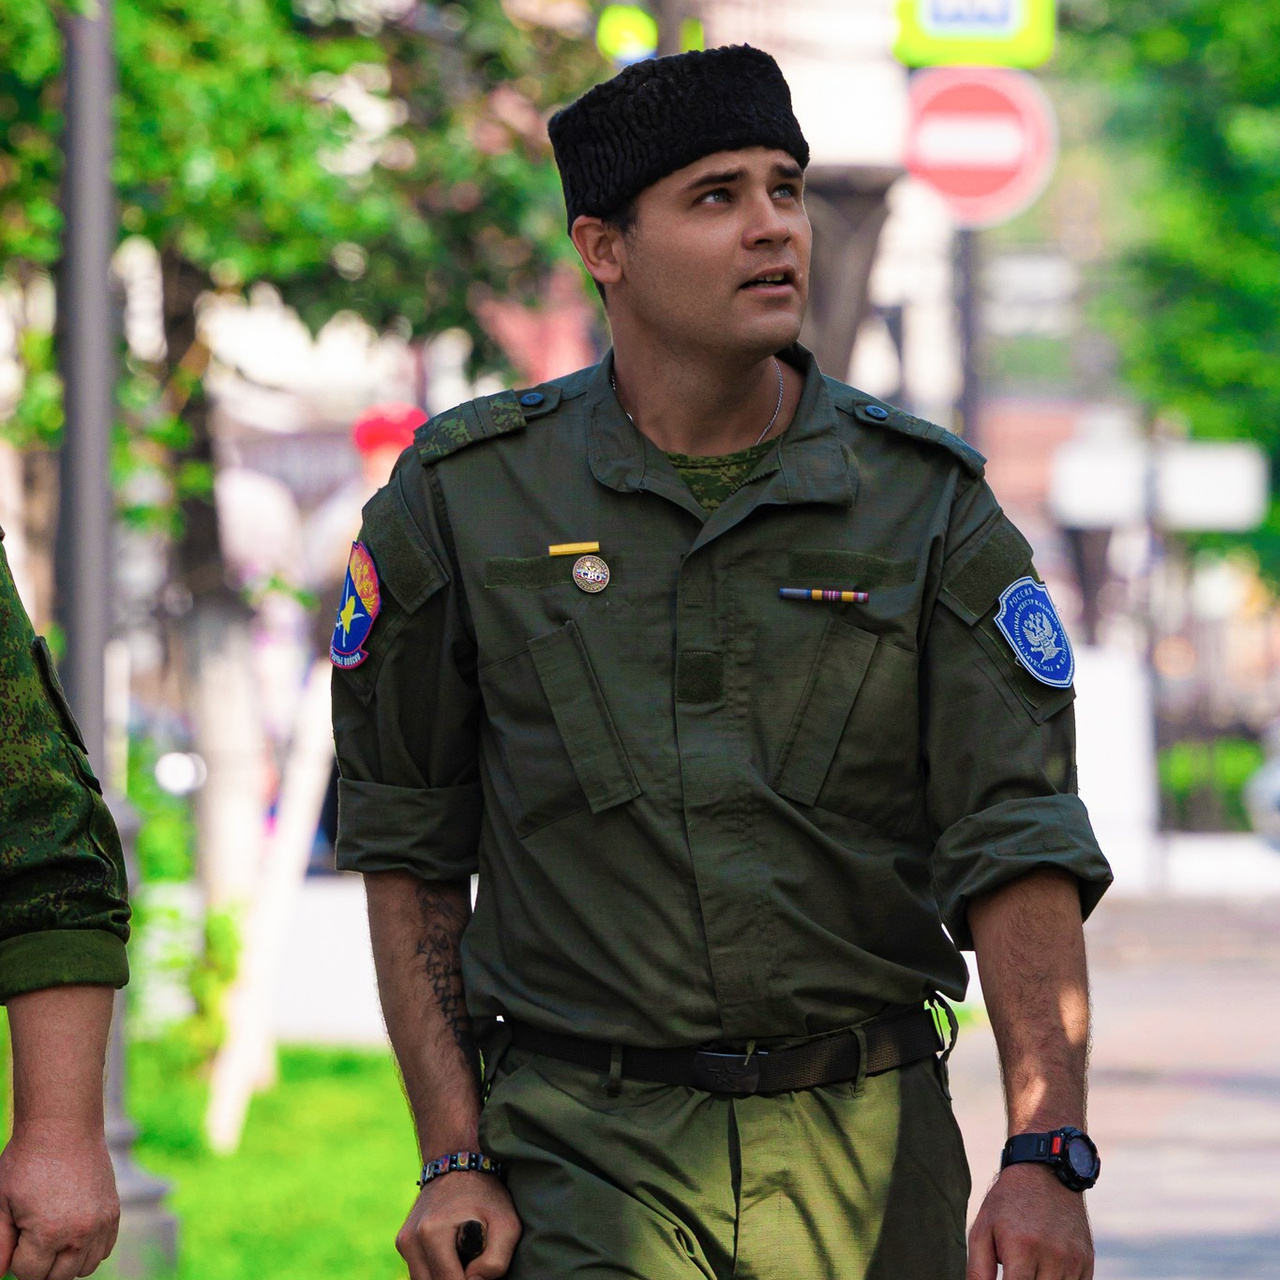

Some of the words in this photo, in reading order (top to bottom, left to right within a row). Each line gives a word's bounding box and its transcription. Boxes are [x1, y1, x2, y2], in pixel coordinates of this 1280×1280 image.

[1008, 587, 1034, 608] РОССИЯ
[1017, 598, 1036, 613] РЕЕСТР
[1013, 611, 1054, 672] ГОСУДАРСТВЕННЫЙ
